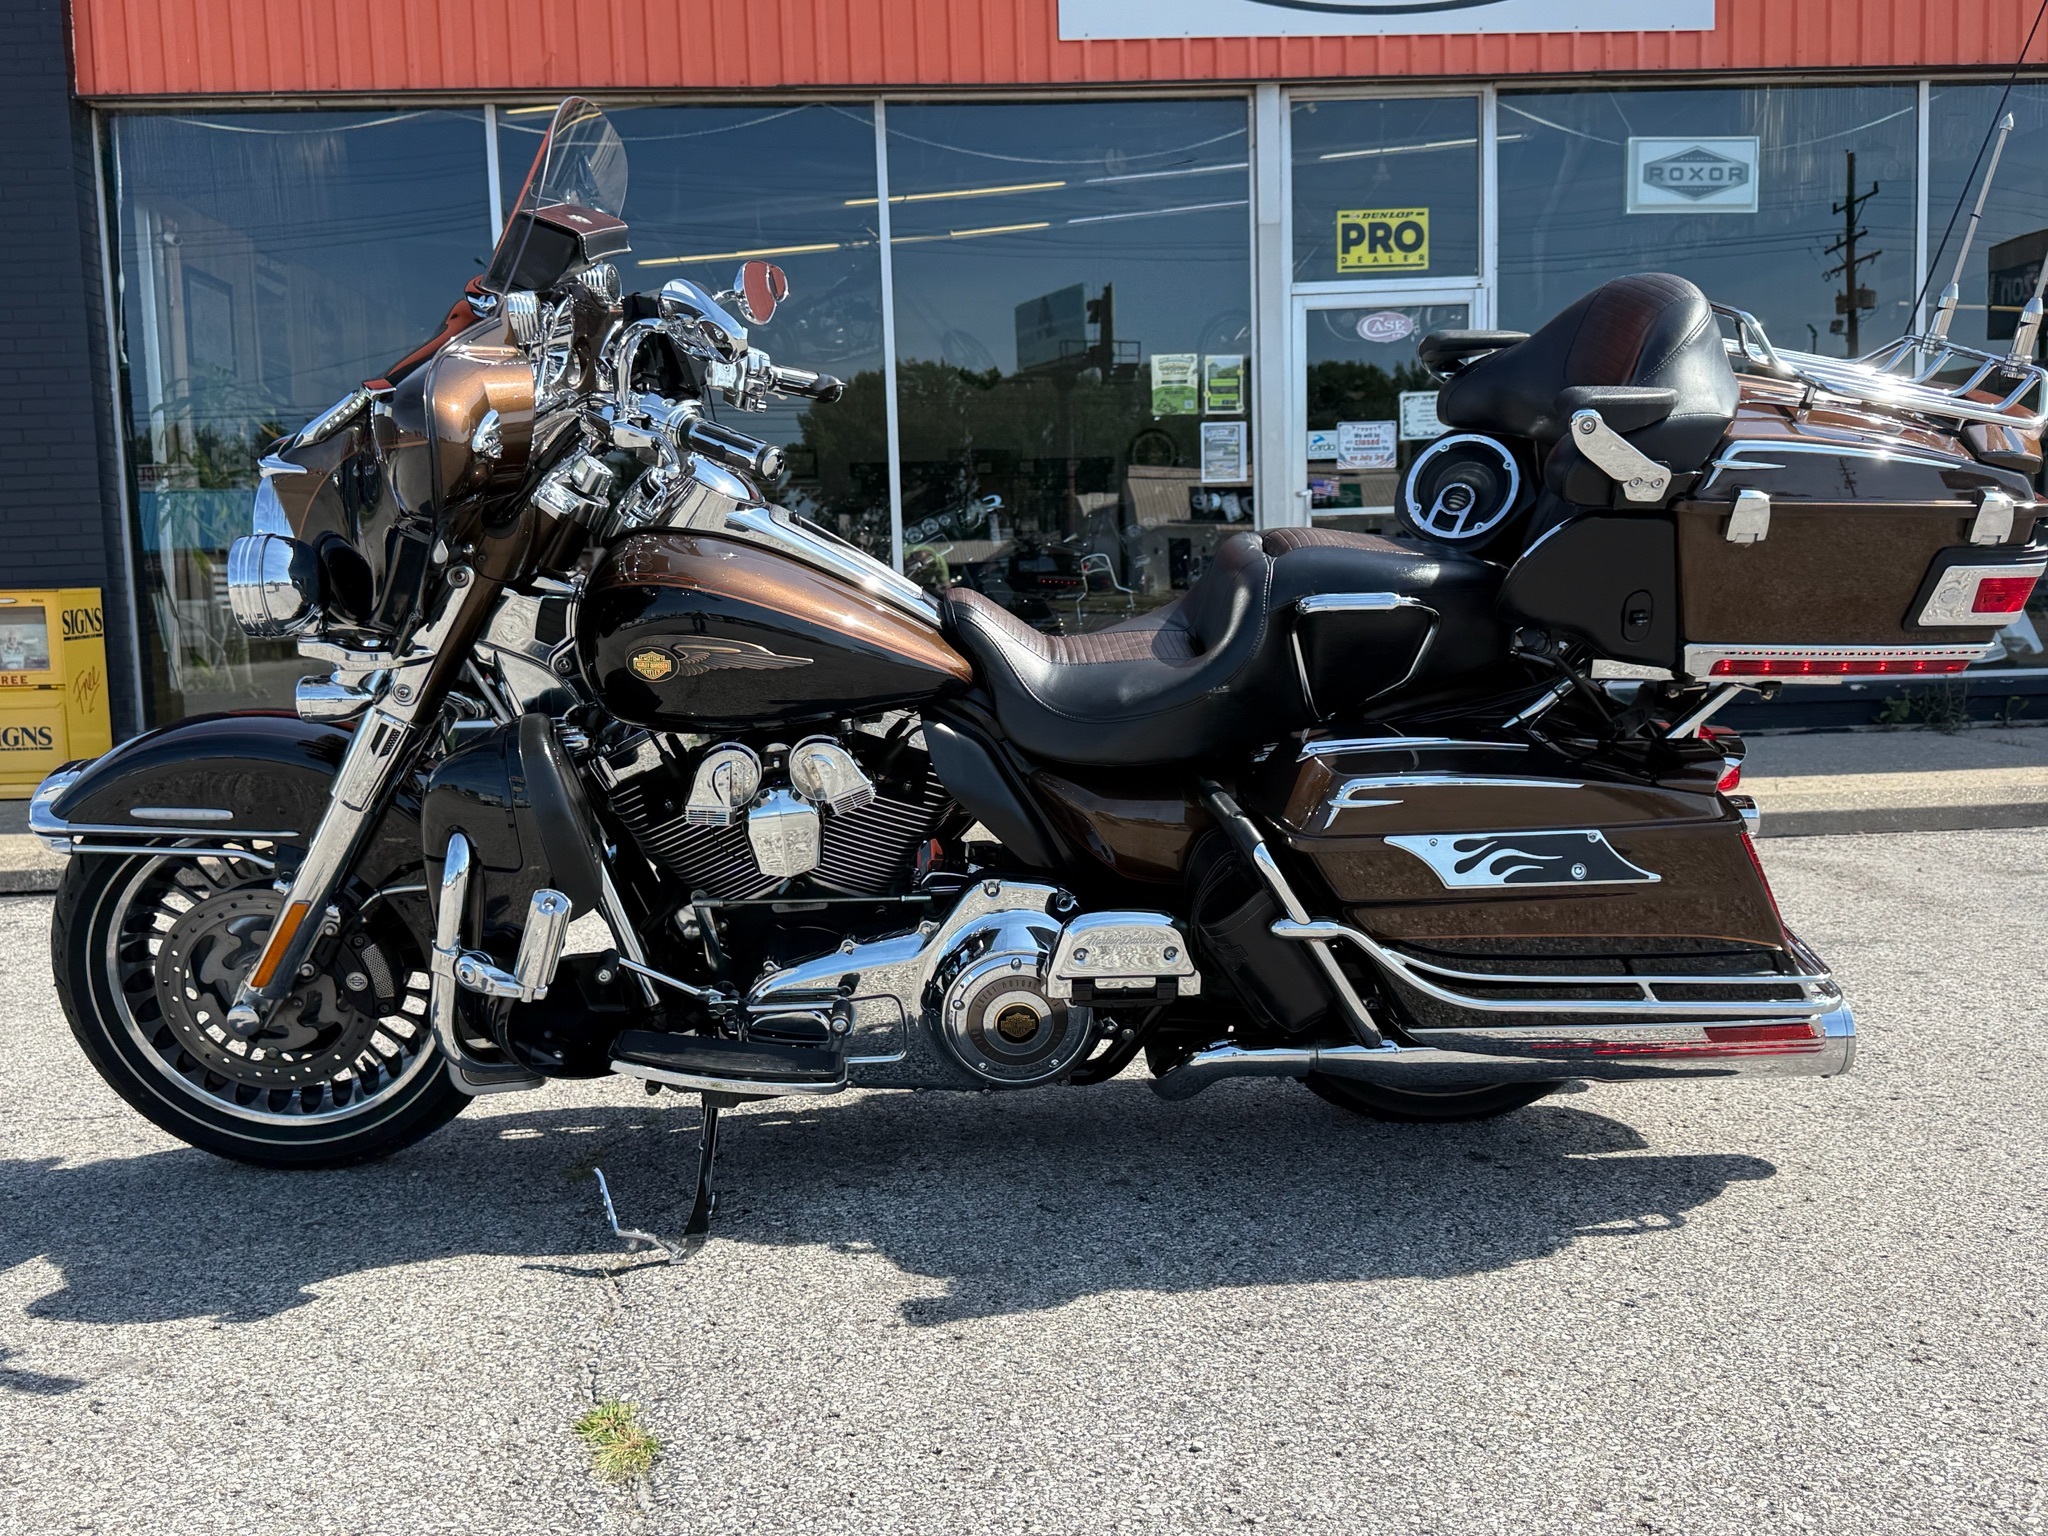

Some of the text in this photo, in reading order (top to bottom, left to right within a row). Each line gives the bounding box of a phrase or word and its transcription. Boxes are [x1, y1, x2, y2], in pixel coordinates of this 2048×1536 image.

[1650, 166, 1743, 181] ROXOR
[1361, 211, 1414, 219] DUNLOP
[1341, 220, 1425, 255] PRO
[1341, 254, 1425, 264] DEALER
[1362, 316, 1408, 337] CASE
[62, 607, 102, 635] SIGNS
[0, 675, 28, 684] REE
[0, 726, 53, 747] GNS
